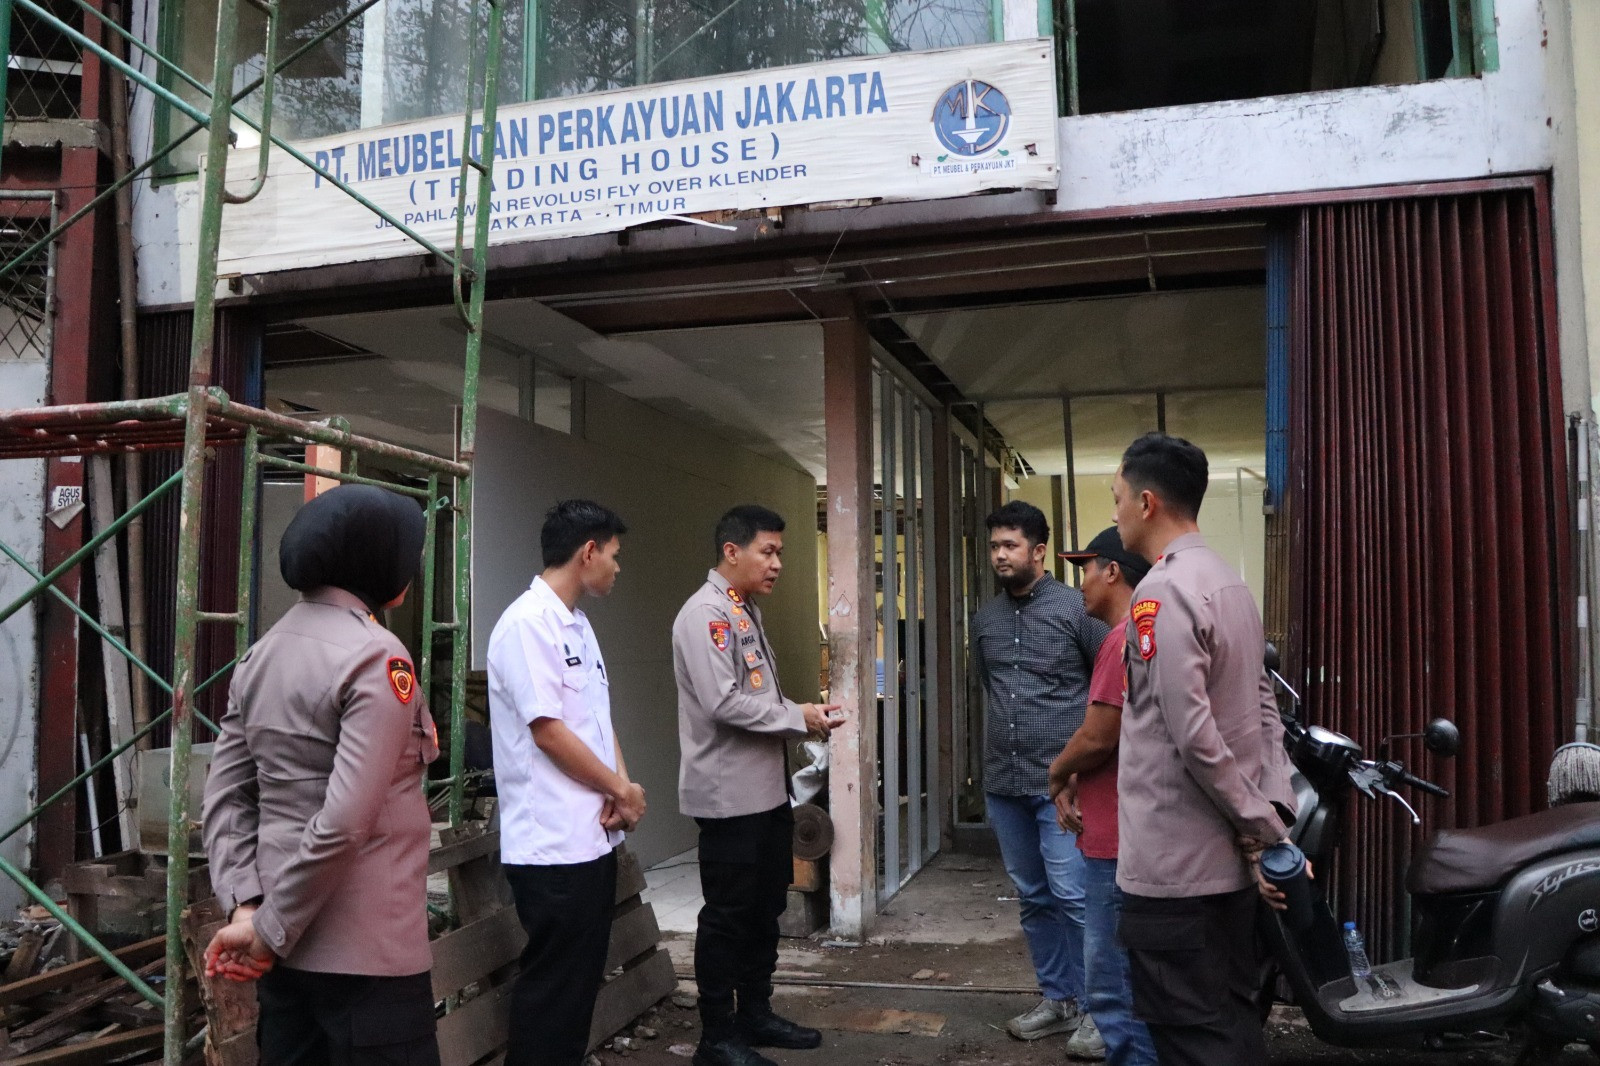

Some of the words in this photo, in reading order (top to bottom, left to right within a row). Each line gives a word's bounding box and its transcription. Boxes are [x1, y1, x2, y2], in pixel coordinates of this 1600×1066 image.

[357, 128, 462, 182] MEUBEL
[471, 117, 528, 163] DAN
[538, 90, 724, 155] PERKAYUAN
[735, 71, 889, 129] JAKARTA
[409, 158, 598, 205] (TRDING
[621, 132, 780, 176] HOUSE)
[942, 165, 963, 175] MEUBEL
[970, 161, 1003, 171] PERKAYUAN
[1004, 160, 1015, 169] JKT
[404, 201, 501, 225] PAHLAWN
[507, 188, 601, 212] REVOLUSI
[607, 184, 641, 199] FLY
[647, 176, 702, 195] OVER
[709, 164, 808, 187] KLENDER
[490, 209, 583, 231] AKARTA
[614, 197, 686, 217] TIMUR
[60, 488, 80, 498] AGUS
[741, 635, 756, 646] ARGA
